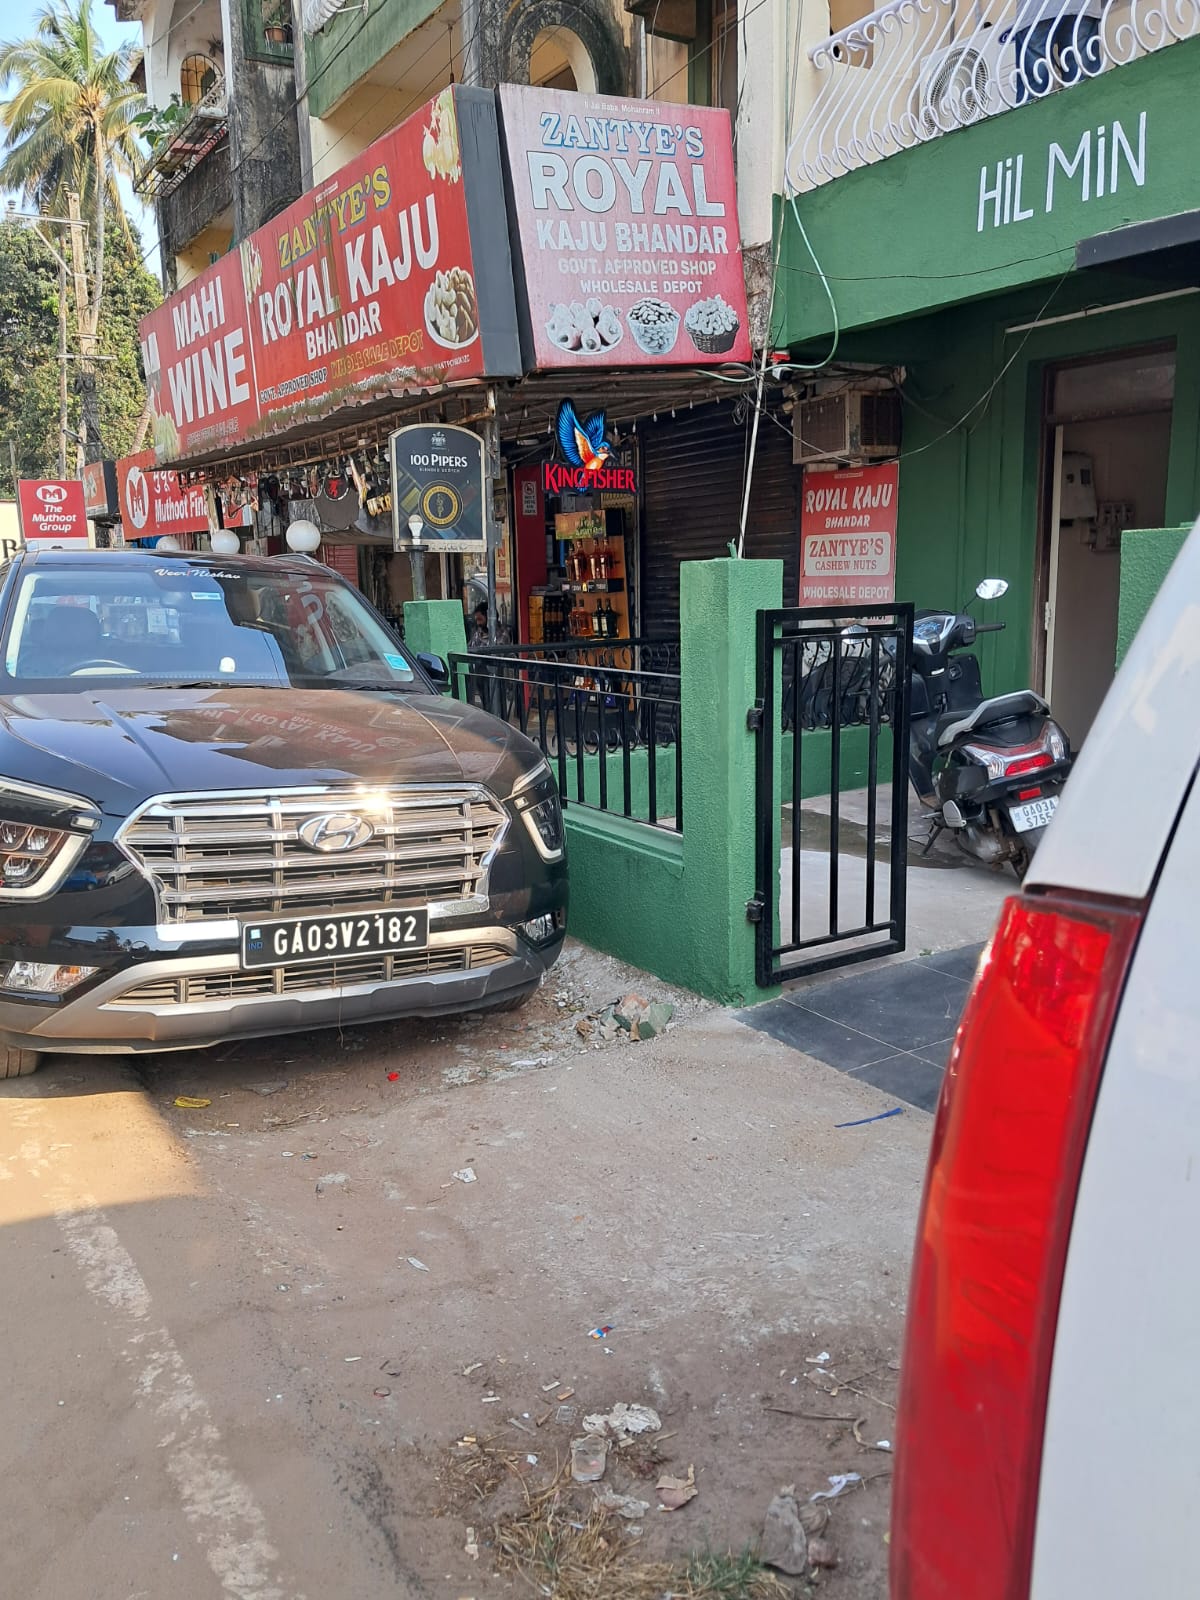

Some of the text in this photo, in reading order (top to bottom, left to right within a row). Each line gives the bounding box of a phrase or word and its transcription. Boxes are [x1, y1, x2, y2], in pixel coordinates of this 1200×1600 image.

[540, 112, 704, 158] ZANTYE'S
[527, 151, 725, 217] ROYAL
[278, 165, 392, 269] ZANTYE'S
[536, 219, 729, 254] KAJU BHANDAR
[258, 193, 440, 346] ROYAL KAJU
[558, 257, 717, 276] GOVT. APPROVED SHOP
[580, 279, 703, 294] WHOLESALE DEPOT
[172, 275, 225, 351] MAHI
[389, 328, 424, 359] DEPOT
[167, 327, 250, 428] WINE
[277, 373, 310, 398] APPROVED
[309, 366, 328, 388] SHOP
[410, 453, 468, 468] 100 PIPERS
[545, 462, 636, 494] KINGFISHER
[44, 504, 63, 513] The
[155, 495, 189, 522] Muthoot
[805, 483, 893, 514] ROYAL KAJU
[32, 513, 77, 523] Muthoot
[39, 522, 72, 533] Group
[825, 514, 870, 529] BHANDAR
[809, 538, 884, 558] ZANTYE'S
[815, 559, 877, 571] CASHEW NUTS
[803, 585, 890, 599] WHOLESALE DEPOT
[1022, 799, 1057, 818] GA03A
[247, 941, 263, 950] IND
[273, 914, 417, 956] GA03V2182
